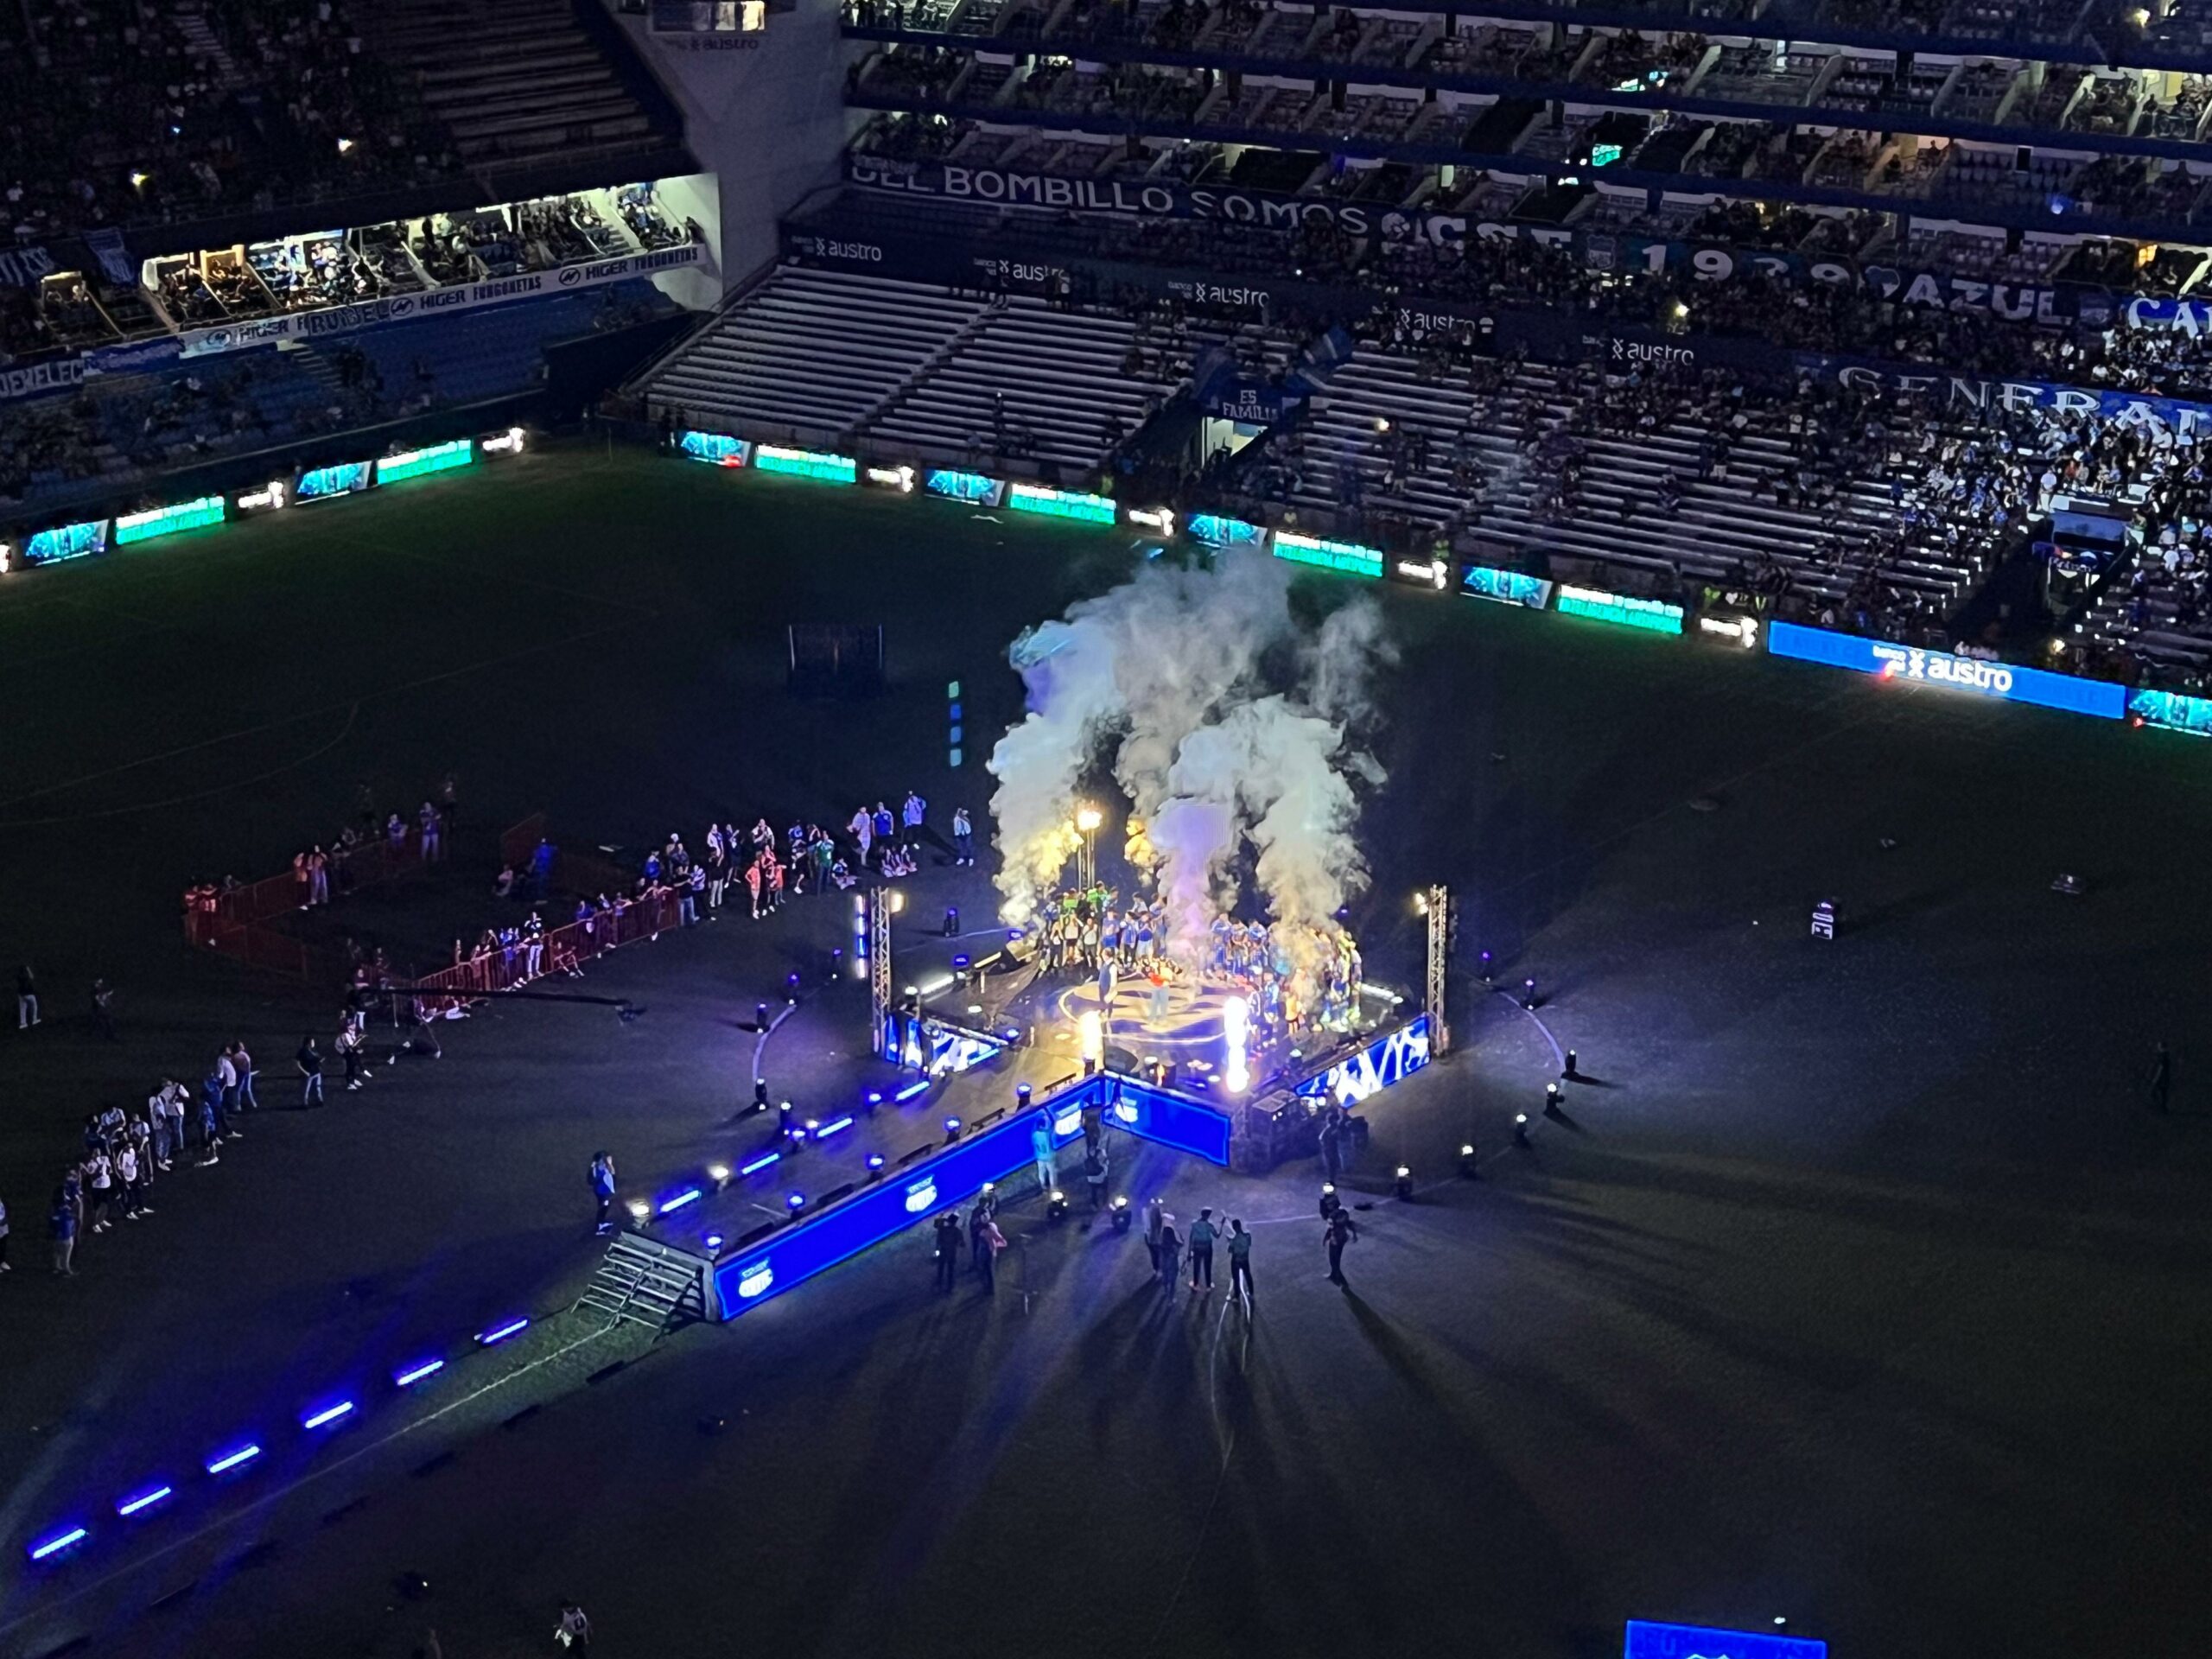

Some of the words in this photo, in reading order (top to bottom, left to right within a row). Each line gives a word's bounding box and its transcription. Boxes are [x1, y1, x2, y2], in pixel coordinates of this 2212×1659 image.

[944, 165, 1173, 213] BOMBILLO
[828, 240, 883, 263] austro
[585, 261, 629, 280] HIGER
[420, 289, 467, 309] HIGER
[1209, 285, 1271, 308] austro
[1903, 273, 2074, 327] AZUL
[1927, 657, 2013, 692] austro
